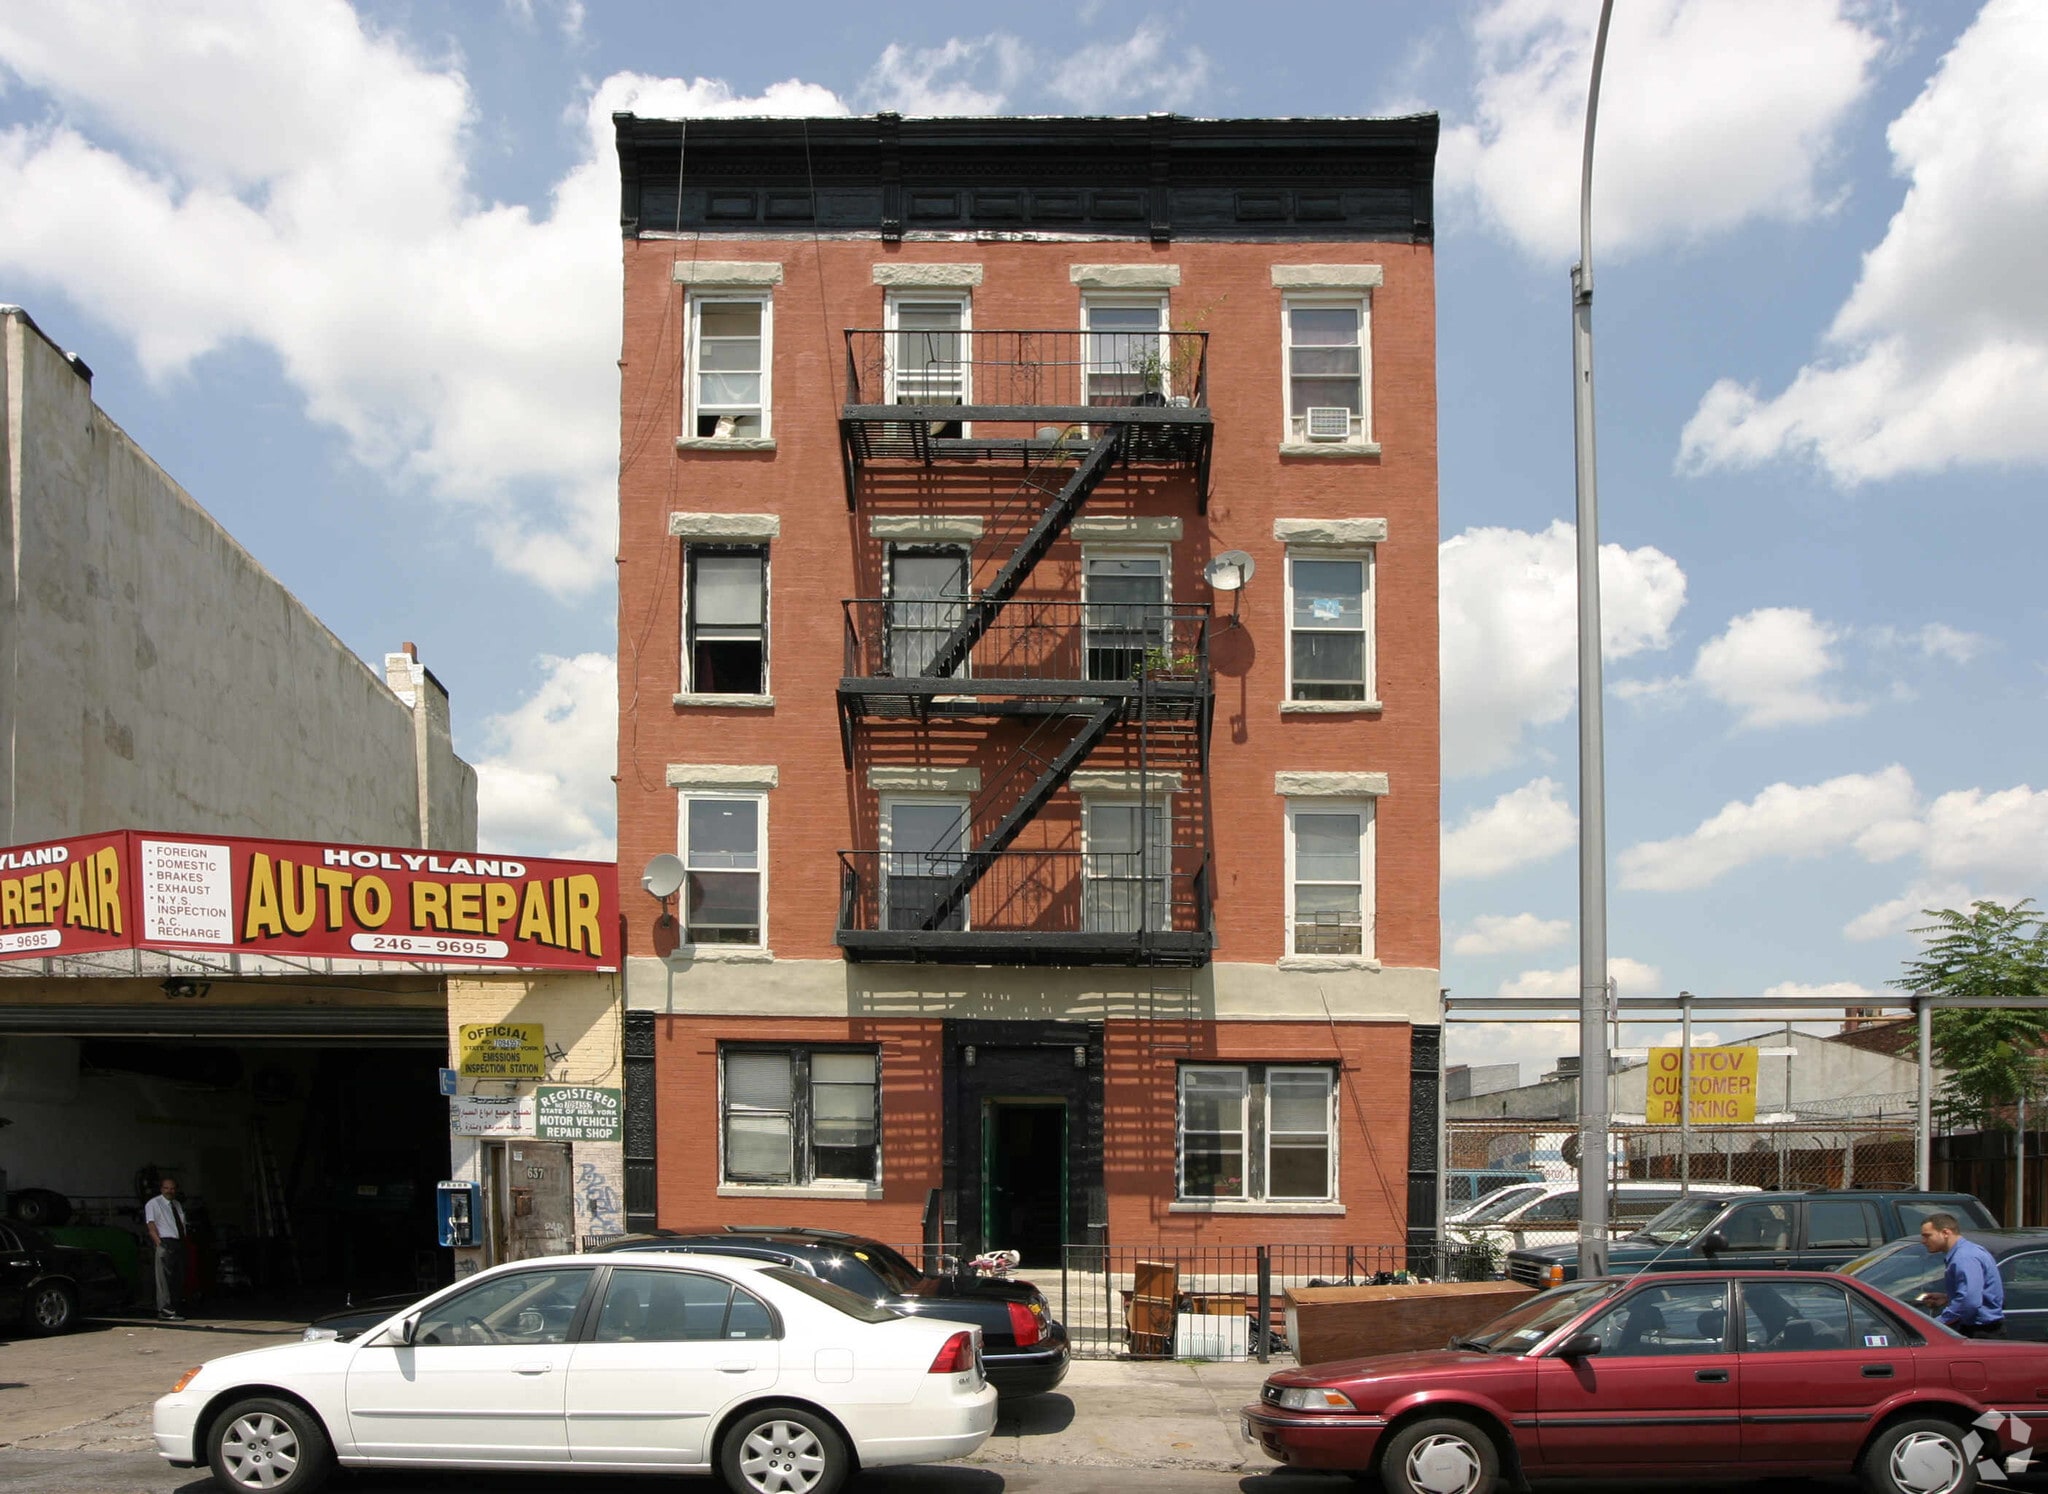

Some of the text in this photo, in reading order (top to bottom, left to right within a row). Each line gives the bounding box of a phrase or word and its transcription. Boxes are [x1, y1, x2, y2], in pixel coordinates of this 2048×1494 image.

[157, 847, 207, 858] FOREIGN
[157, 859, 216, 871] DOMESTIC
[323, 849, 526, 877] HOLYLAND
[157, 871, 203, 882] BRAKES
[1, 846, 122, 936] REPAIR
[157, 883, 210, 895] EXHAUST
[157, 895, 191, 905] N.Y.S.
[243, 852, 602, 957] AUTO REPAIR
[158, 905, 226, 917] INSPECTION
[158, 917, 181, 926] A.C.
[158, 926, 221, 938] RECHARGE
[468, 1026, 527, 1042] OFFICIAL
[483, 1053, 520, 1062] EMISSIONS
[466, 1064, 538, 1074] INSPECTION STATION
[540, 1088, 617, 1108] REGISTERED
[540, 1115, 618, 1127] MOTOR VEHICLE
[547, 1127, 613, 1138] REPAIR SHOP
[527, 1167, 545, 1179] 637
